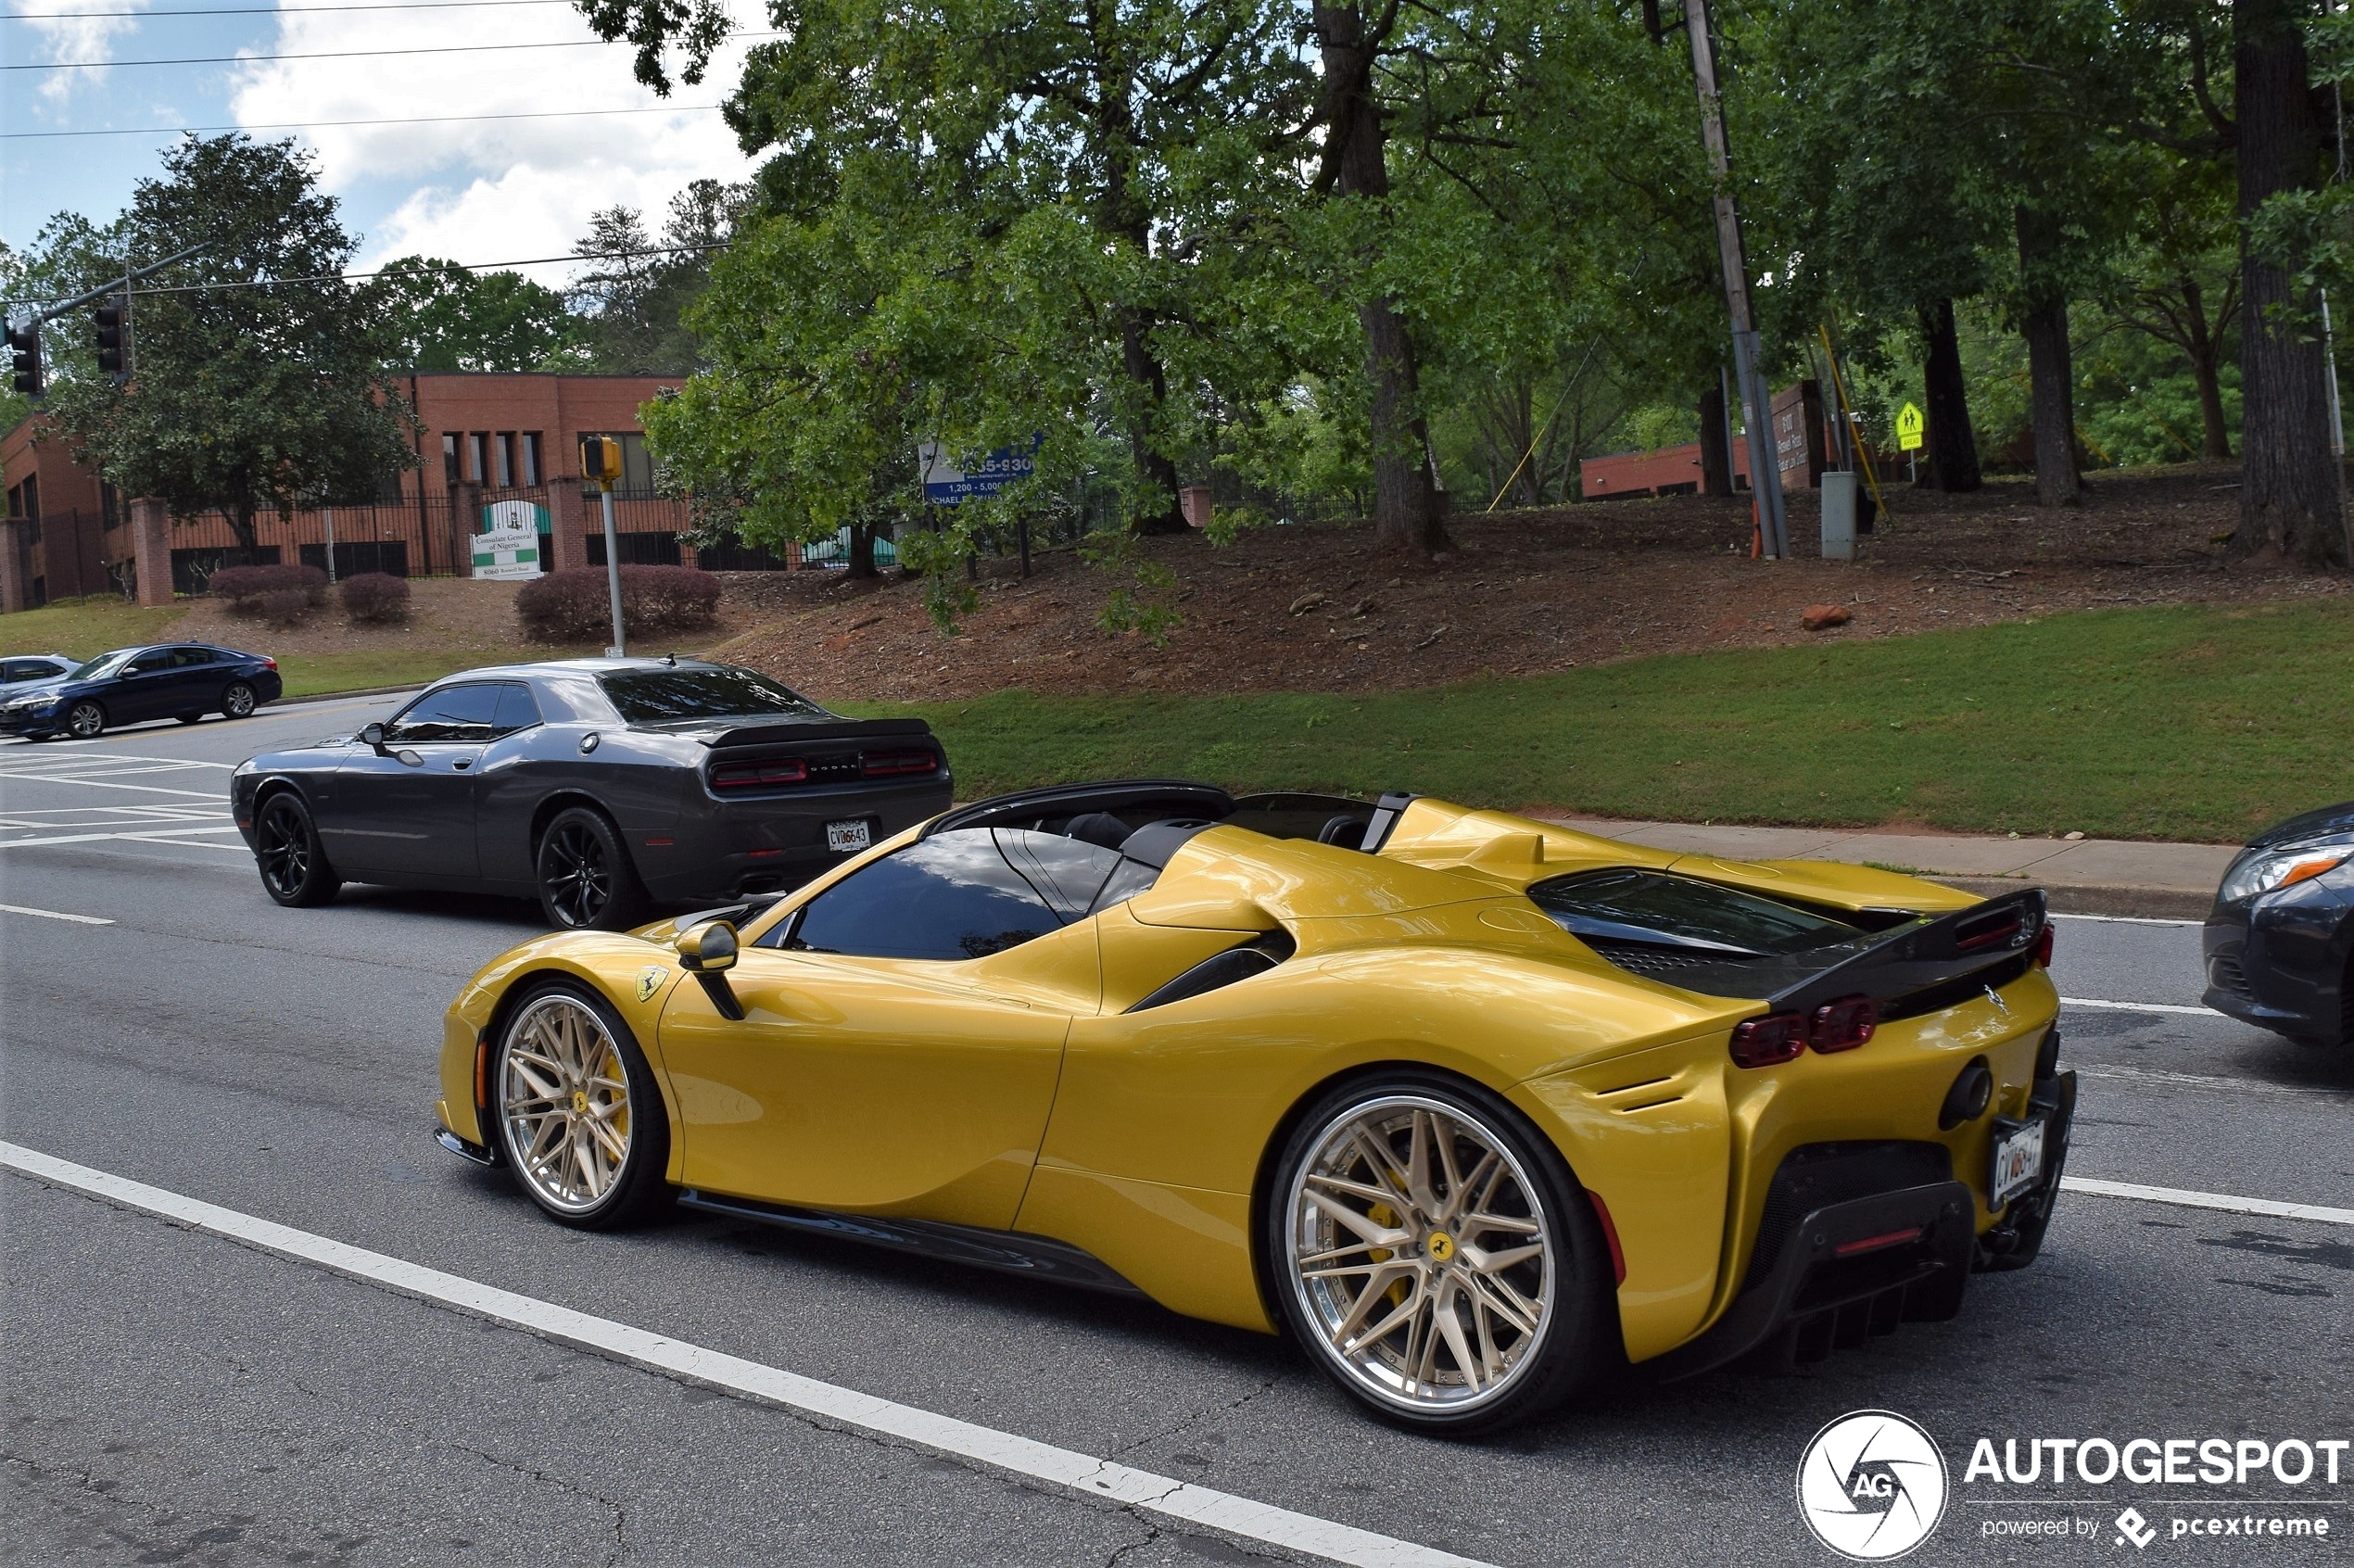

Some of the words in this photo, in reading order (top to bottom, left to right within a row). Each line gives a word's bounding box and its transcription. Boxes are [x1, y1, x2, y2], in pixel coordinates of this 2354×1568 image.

[949, 484, 972, 493] 1,200
[930, 496, 960, 505] ICHAEL
[476, 537, 507, 545] Consulate
[507, 533, 532, 541] General
